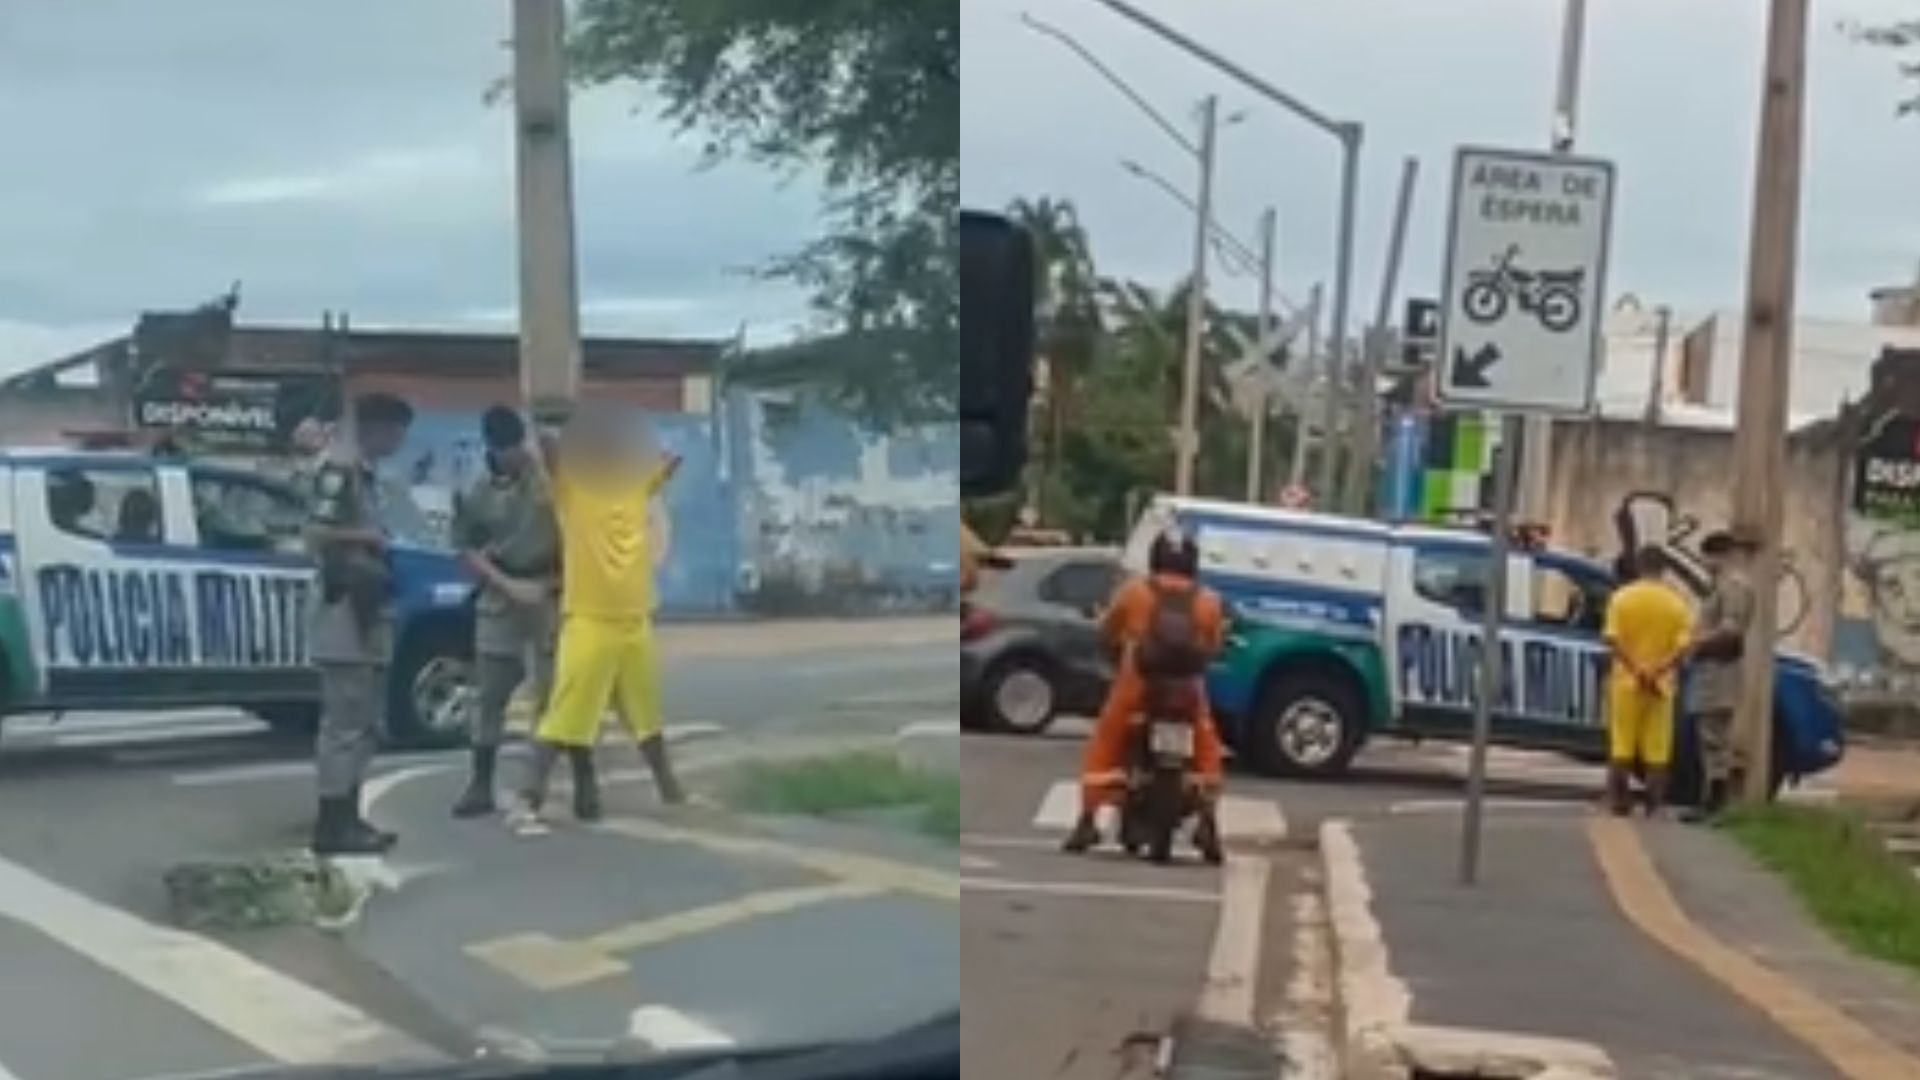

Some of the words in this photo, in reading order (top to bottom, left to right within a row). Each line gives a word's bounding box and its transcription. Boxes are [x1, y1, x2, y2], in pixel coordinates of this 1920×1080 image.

[1562, 173, 1598, 199] DE
[1480, 195, 1581, 224] ESPERA
[142, 400, 277, 430] DISPONÍVEL
